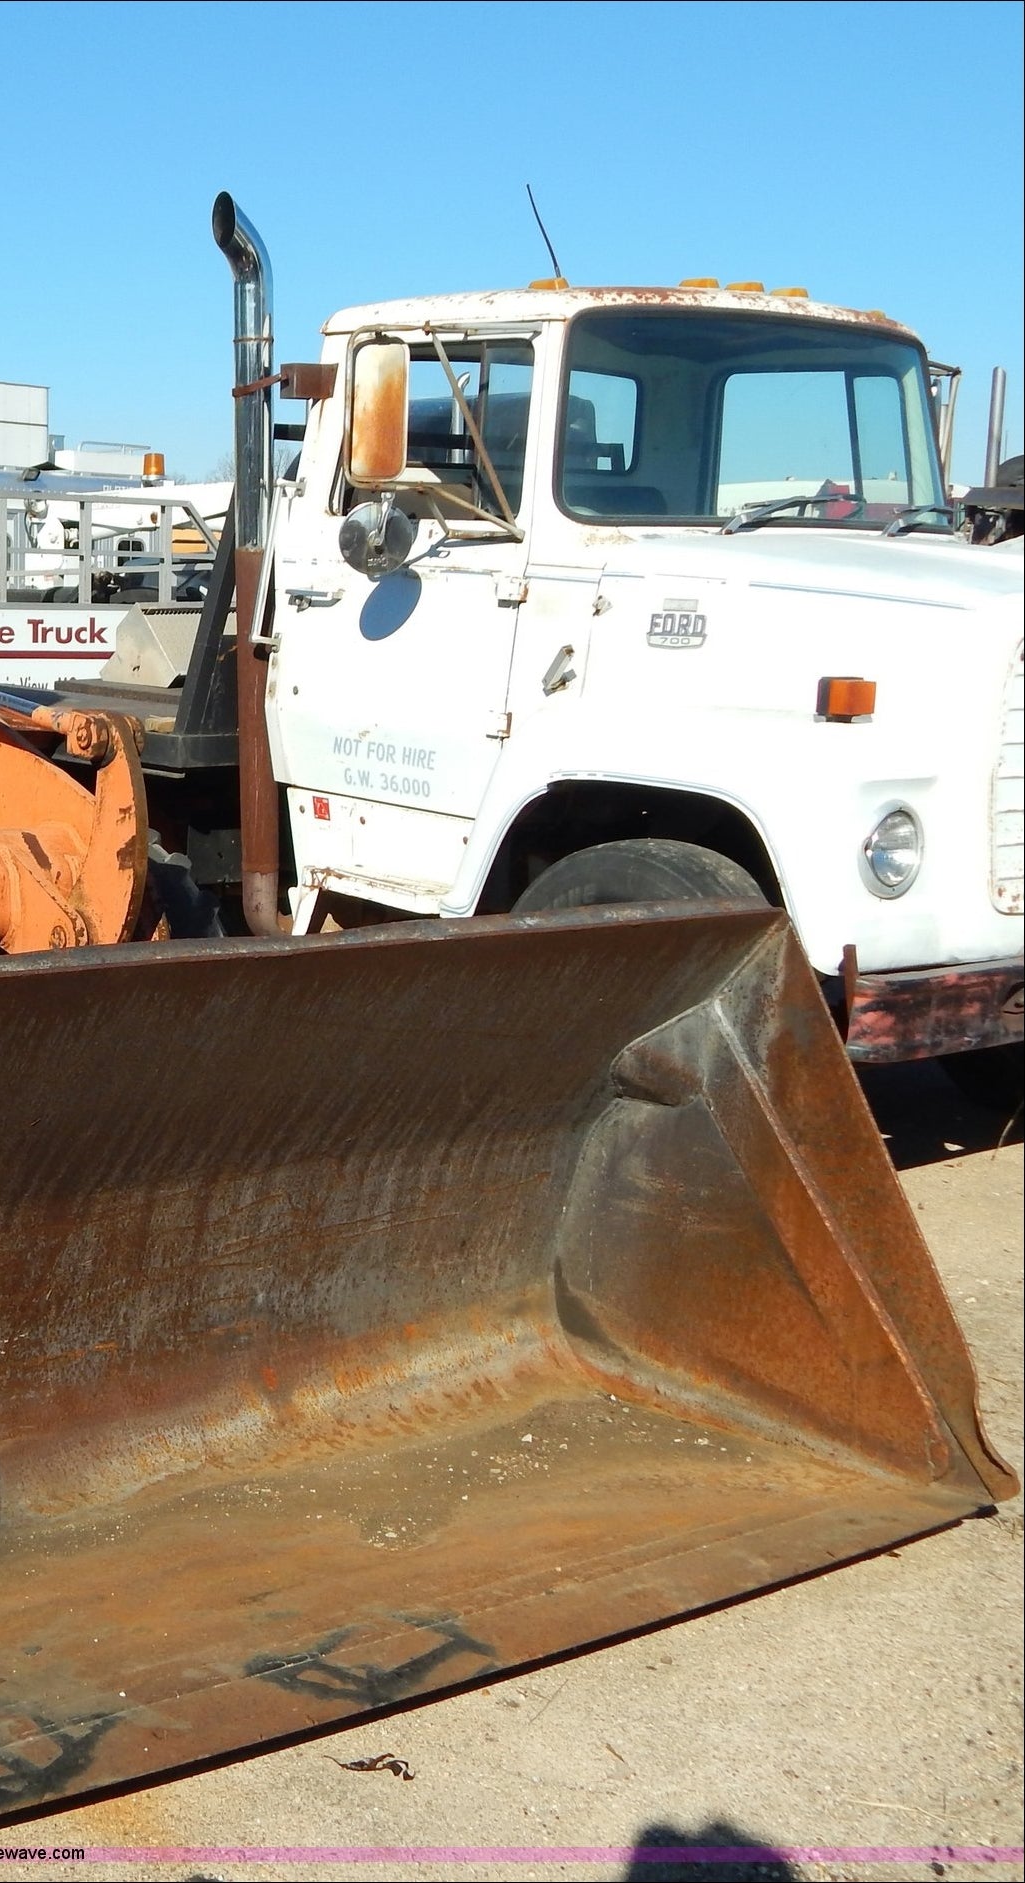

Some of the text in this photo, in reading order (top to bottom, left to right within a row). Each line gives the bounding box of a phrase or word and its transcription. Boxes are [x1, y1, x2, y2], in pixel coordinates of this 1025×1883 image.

[27, 617, 108, 644] Truck
[649, 613, 707, 637] FORD
[659, 637, 690, 645] 700
[333, 736, 436, 770] NOT FOR HIRE
[344, 767, 431, 798] G.W. 36,000
